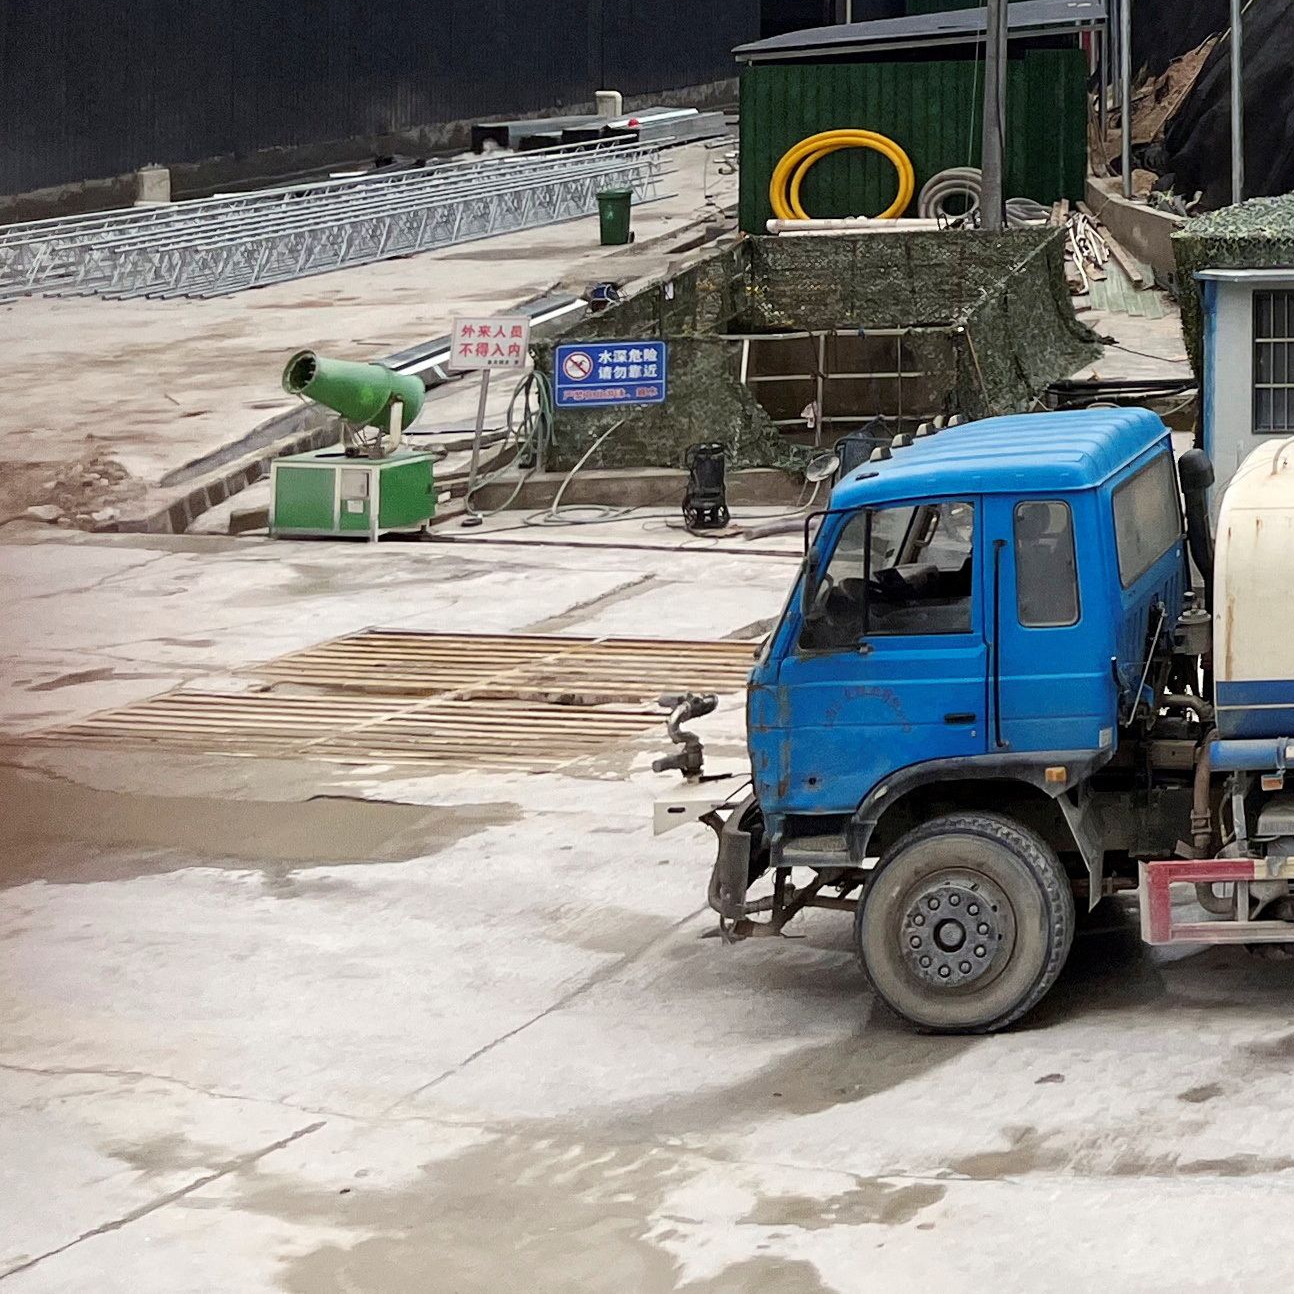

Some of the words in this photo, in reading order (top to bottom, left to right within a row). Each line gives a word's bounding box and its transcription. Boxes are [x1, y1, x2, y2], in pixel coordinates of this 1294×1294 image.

[460, 323, 523, 339] 外来人员
[458, 341, 521, 358] 不得入内
[597, 347, 659, 365] 水深危险
[597, 363, 659, 380] 请勿靠近
